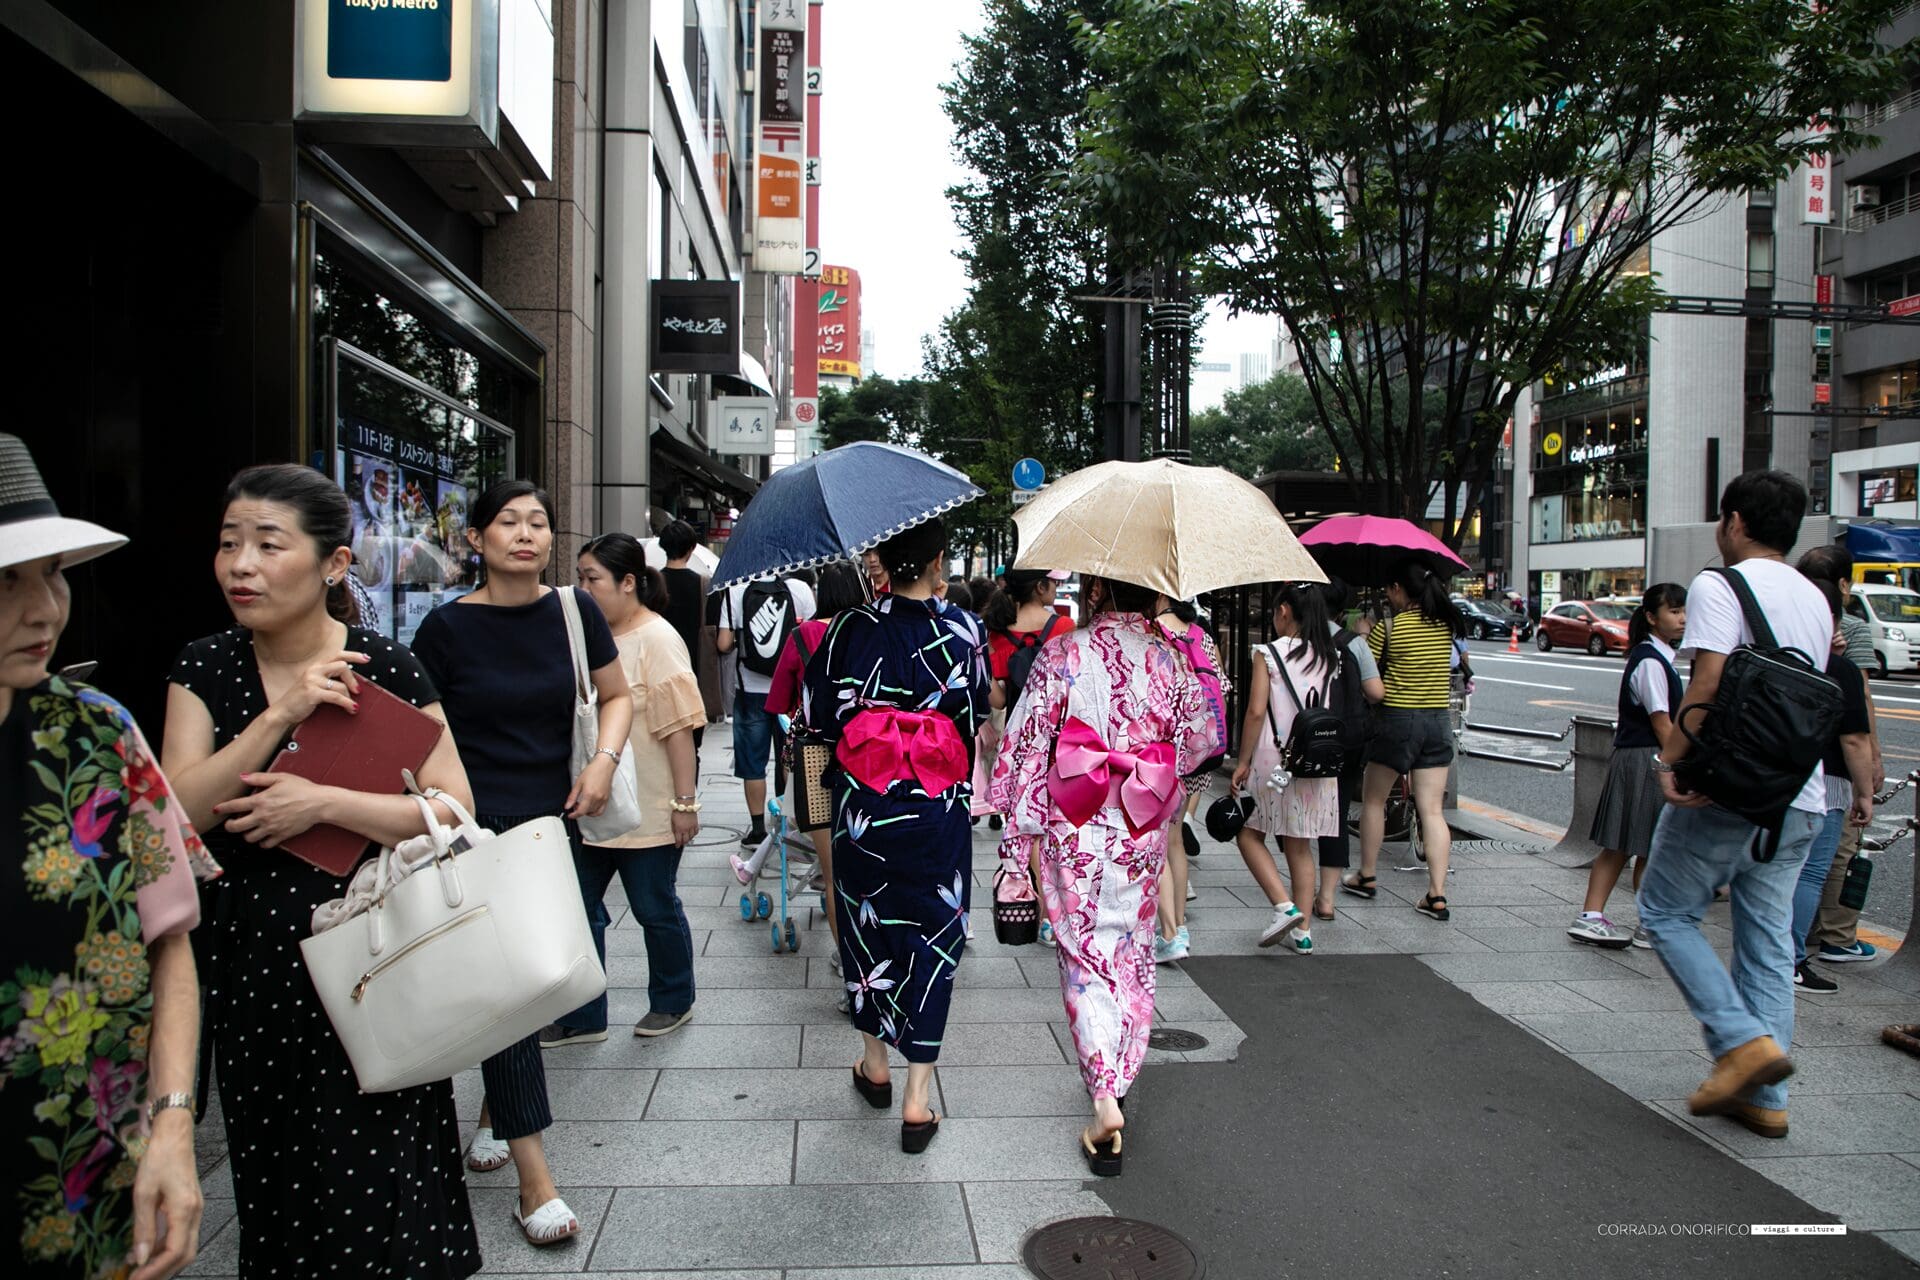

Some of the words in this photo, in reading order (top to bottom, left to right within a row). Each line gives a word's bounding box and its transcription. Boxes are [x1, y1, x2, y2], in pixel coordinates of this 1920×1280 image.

[391, 0, 438, 9] Metro
[820, 267, 849, 286] &B
[663, 317, 727, 334] やまと屋
